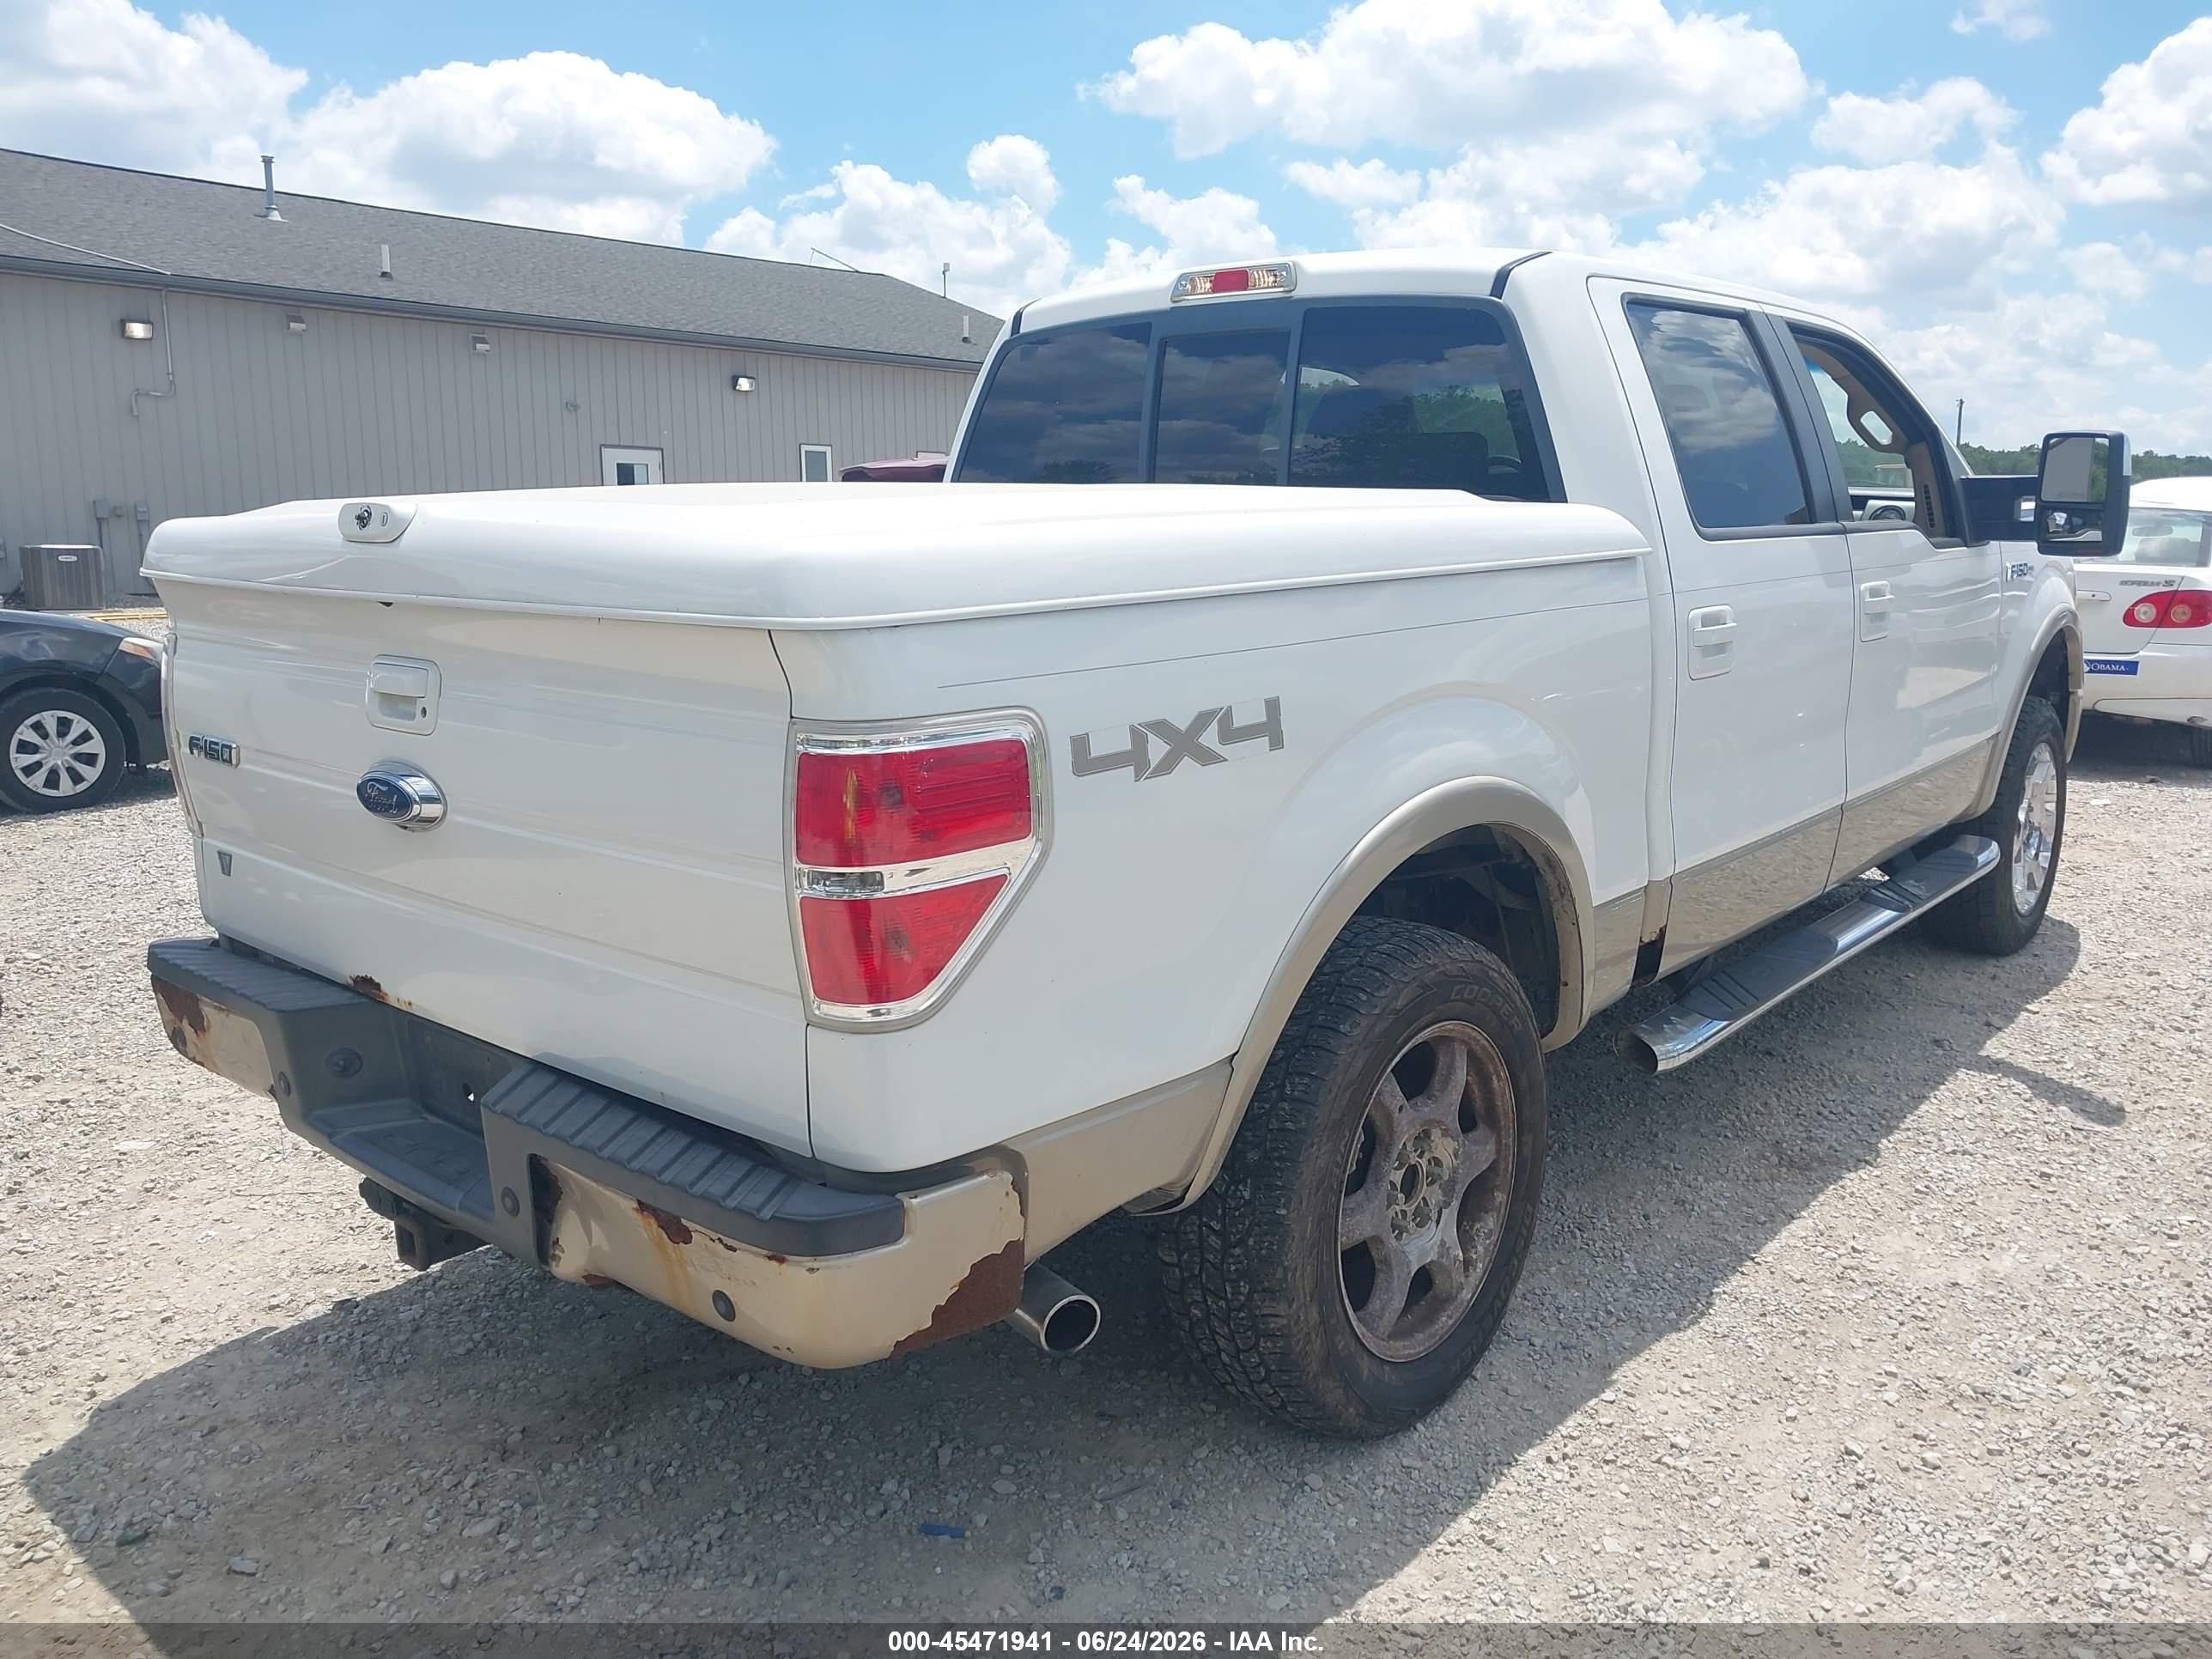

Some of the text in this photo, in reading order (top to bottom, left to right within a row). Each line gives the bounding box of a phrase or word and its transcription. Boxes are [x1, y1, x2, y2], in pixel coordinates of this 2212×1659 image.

[2091, 662, 2126, 672] OBAMA
[1069, 696, 1285, 782] 4X4
[364, 781, 399, 814] Ford
[1450, 983, 1522, 1030] COOPER
